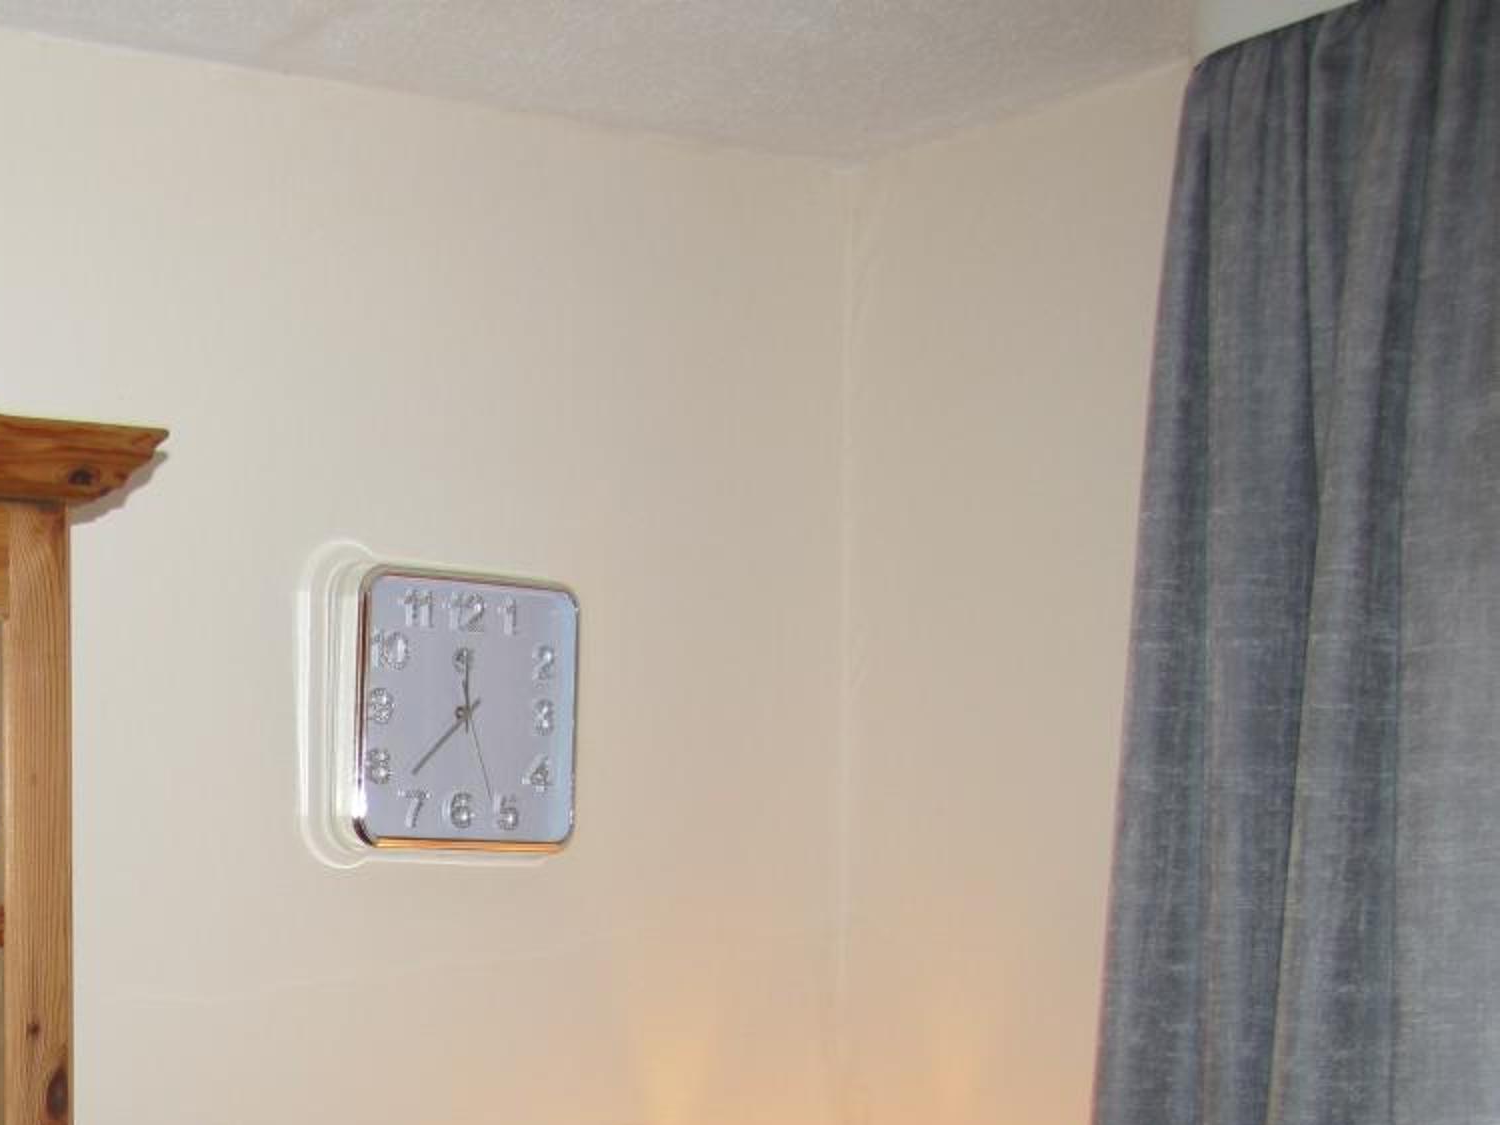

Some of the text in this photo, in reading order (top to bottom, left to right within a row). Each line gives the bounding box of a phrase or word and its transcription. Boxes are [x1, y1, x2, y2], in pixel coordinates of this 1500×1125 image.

[401, 590, 517, 635] 11 12 1
[372, 629, 409, 670] 10
[533, 646, 555, 682] 2
[534, 699, 554, 735] 3
[367, 748, 392, 785] 8
[523, 755, 551, 792] 4
[398, 787, 519, 830] 7 6 5
